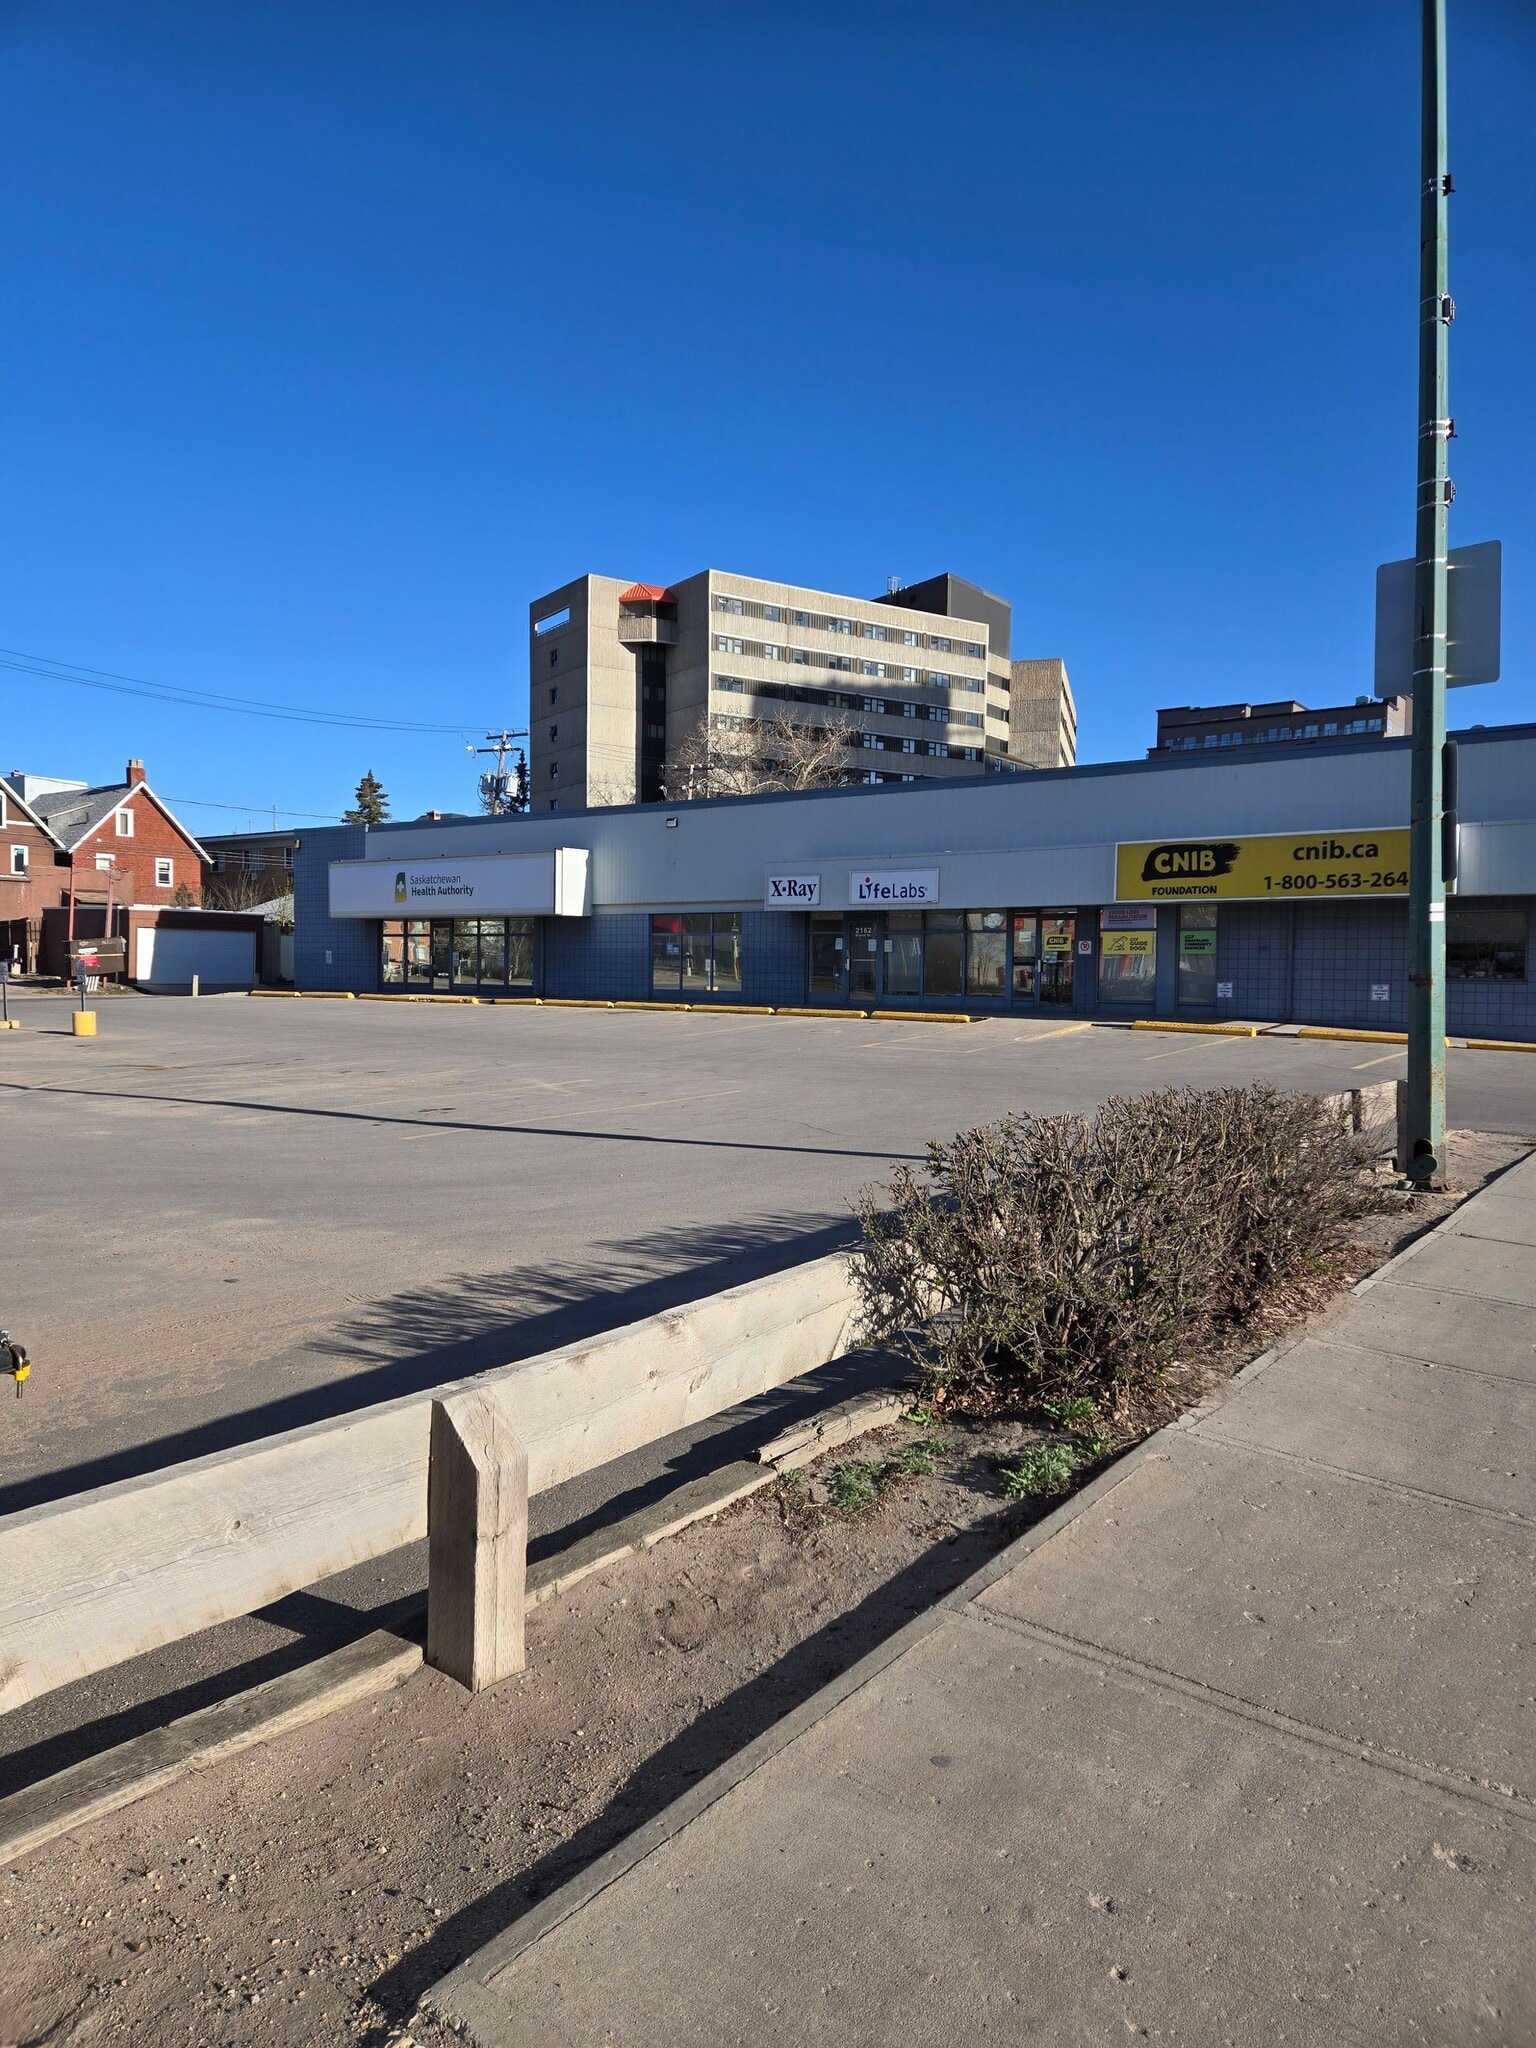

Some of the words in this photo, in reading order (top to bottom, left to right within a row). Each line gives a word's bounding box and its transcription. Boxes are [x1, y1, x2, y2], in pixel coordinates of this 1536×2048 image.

[1293, 840, 1379, 861] cnib.ca
[1154, 850, 1216, 874] CNIB
[410, 874, 461, 885] Saskatchewan
[859, 877, 926, 899] LifeLabs
[1264, 871, 1409, 890] 1-800-563-264
[411, 886, 436, 896] Health
[437, 885, 474, 897] Authority
[771, 880, 817, 901] X-Ray
[1152, 885, 1217, 896] FOUNDATION
